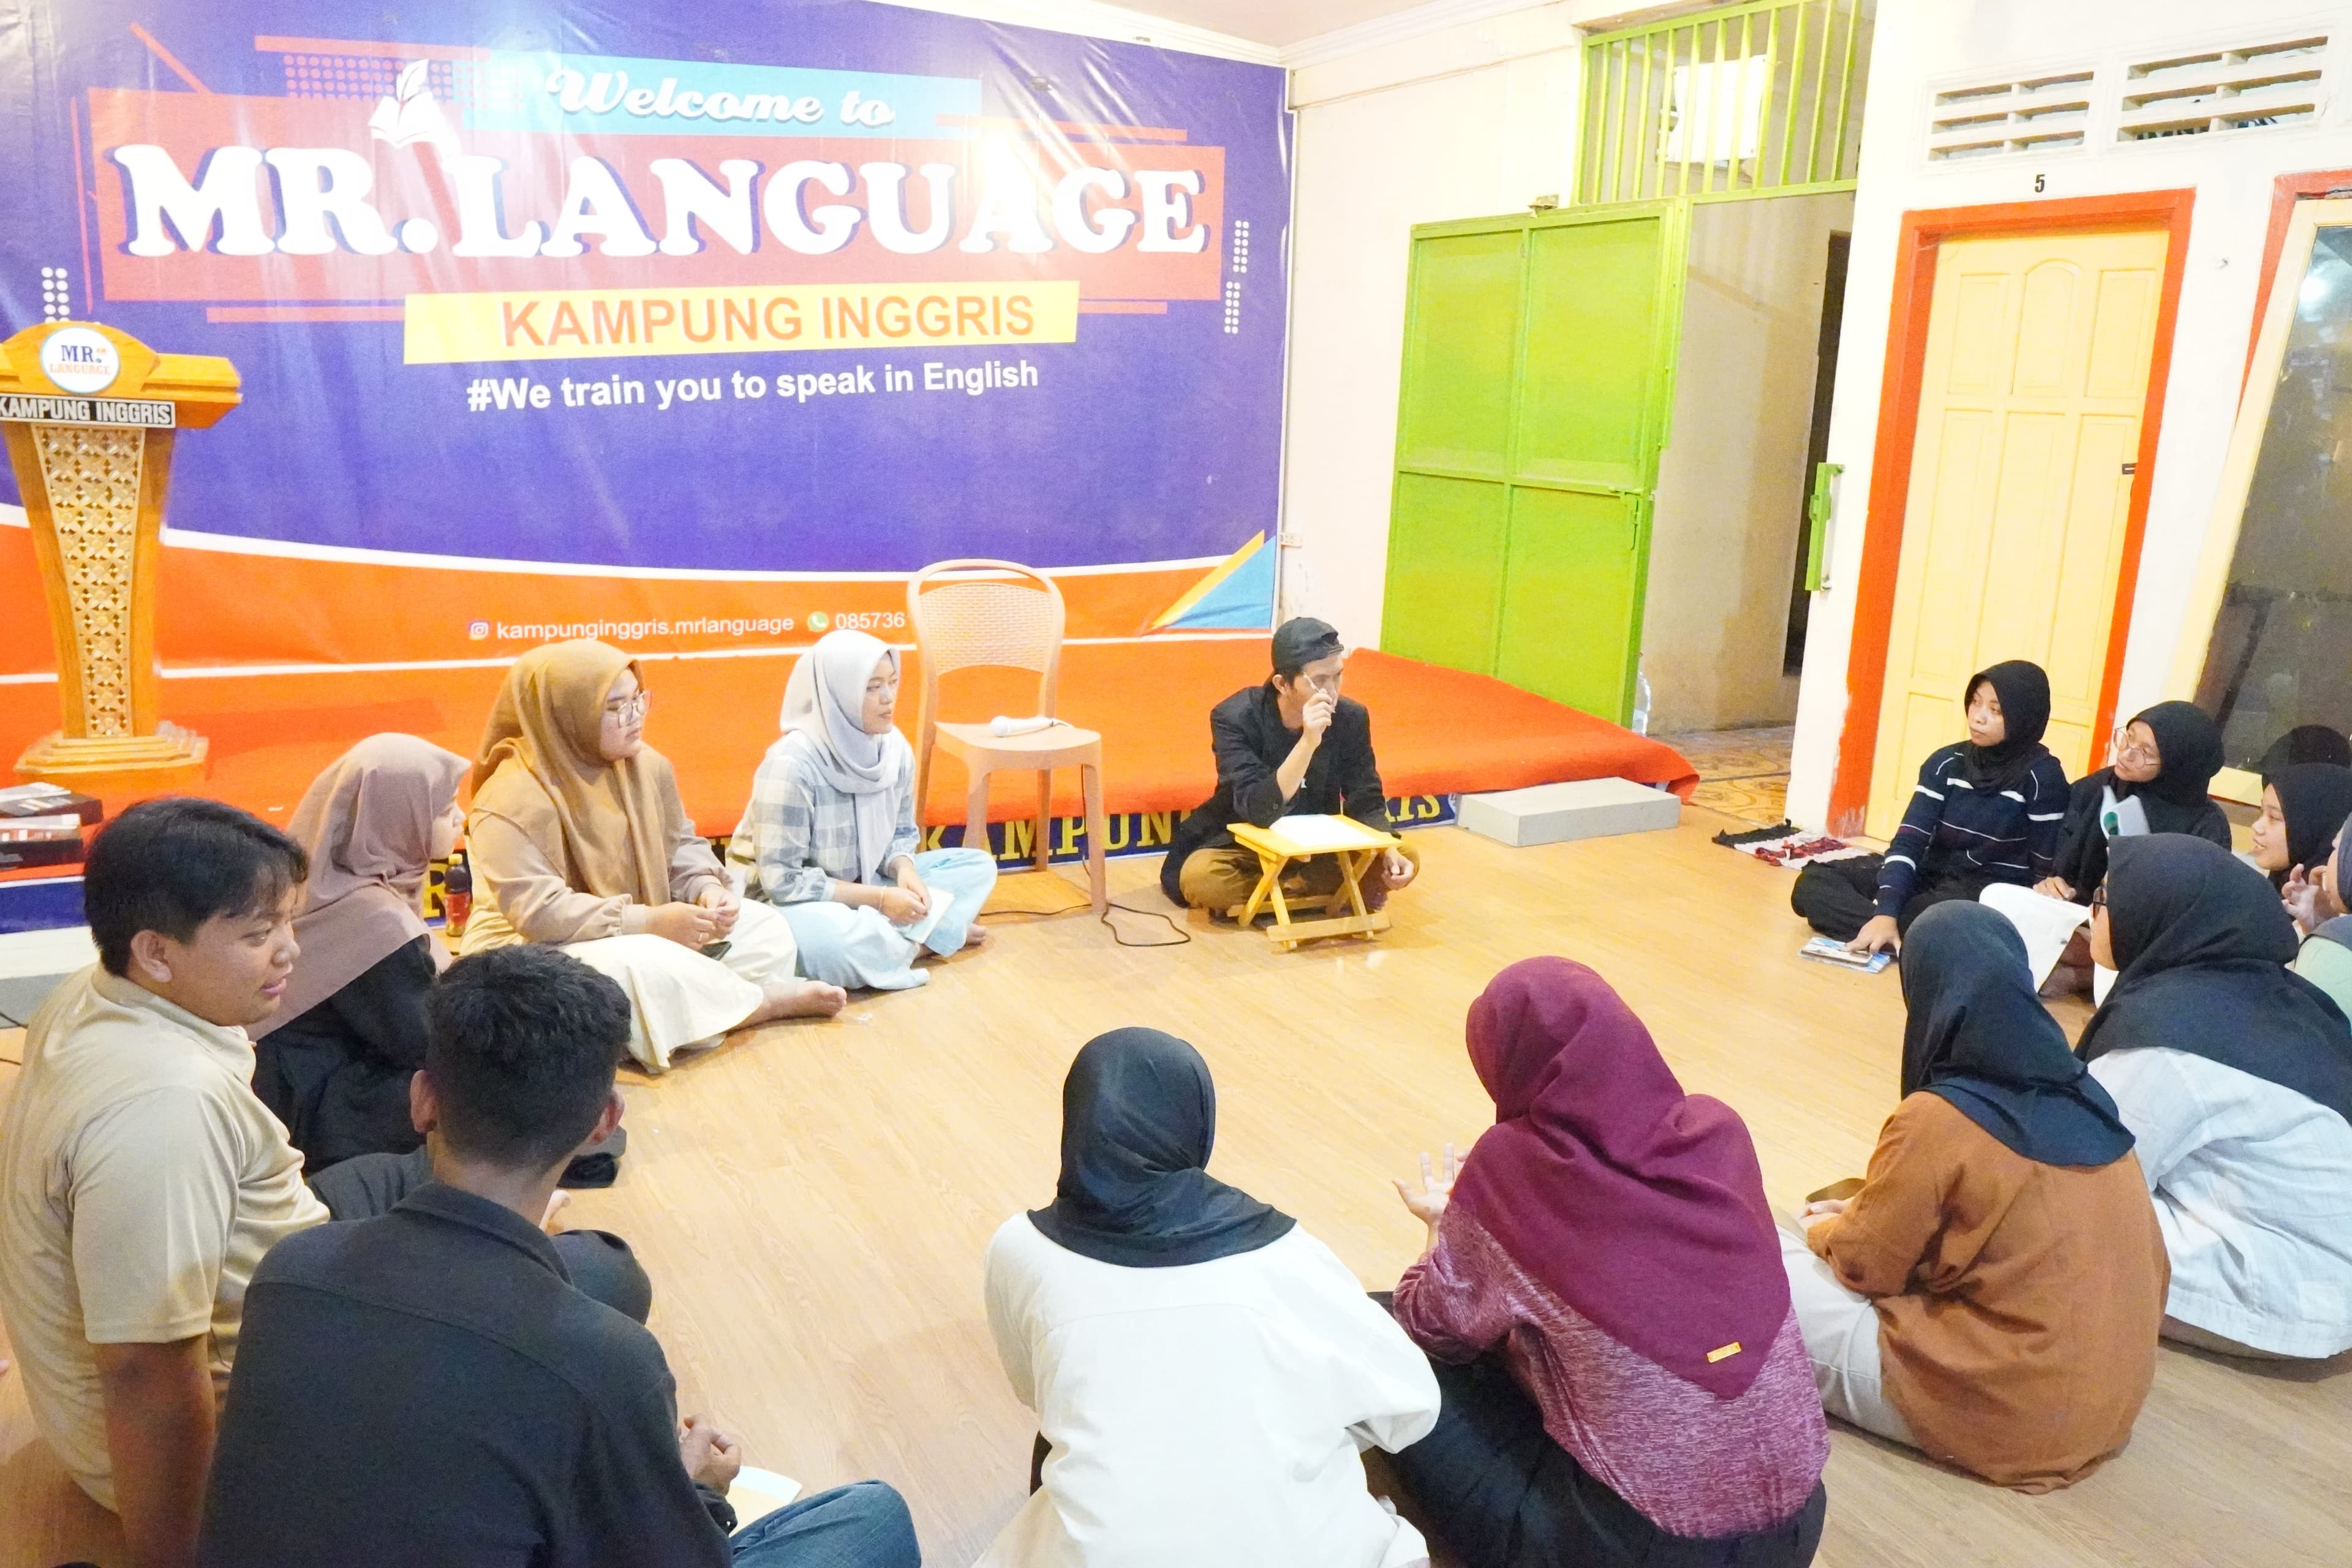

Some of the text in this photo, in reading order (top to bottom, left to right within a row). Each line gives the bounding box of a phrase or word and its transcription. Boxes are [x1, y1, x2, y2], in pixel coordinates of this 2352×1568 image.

[546, 69, 896, 128] Welcome to
[2035, 173, 2045, 193] 5
[502, 295, 1035, 347] KAMPUNG INGGRIS
[60, 344, 103, 363] MR.
[466, 360, 1039, 412] #We train you to speak in English
[0, 396, 172, 424] KAMPUNG INGGRIS
[497, 611, 910, 641] kampunginggris.mrlanguage 085736
